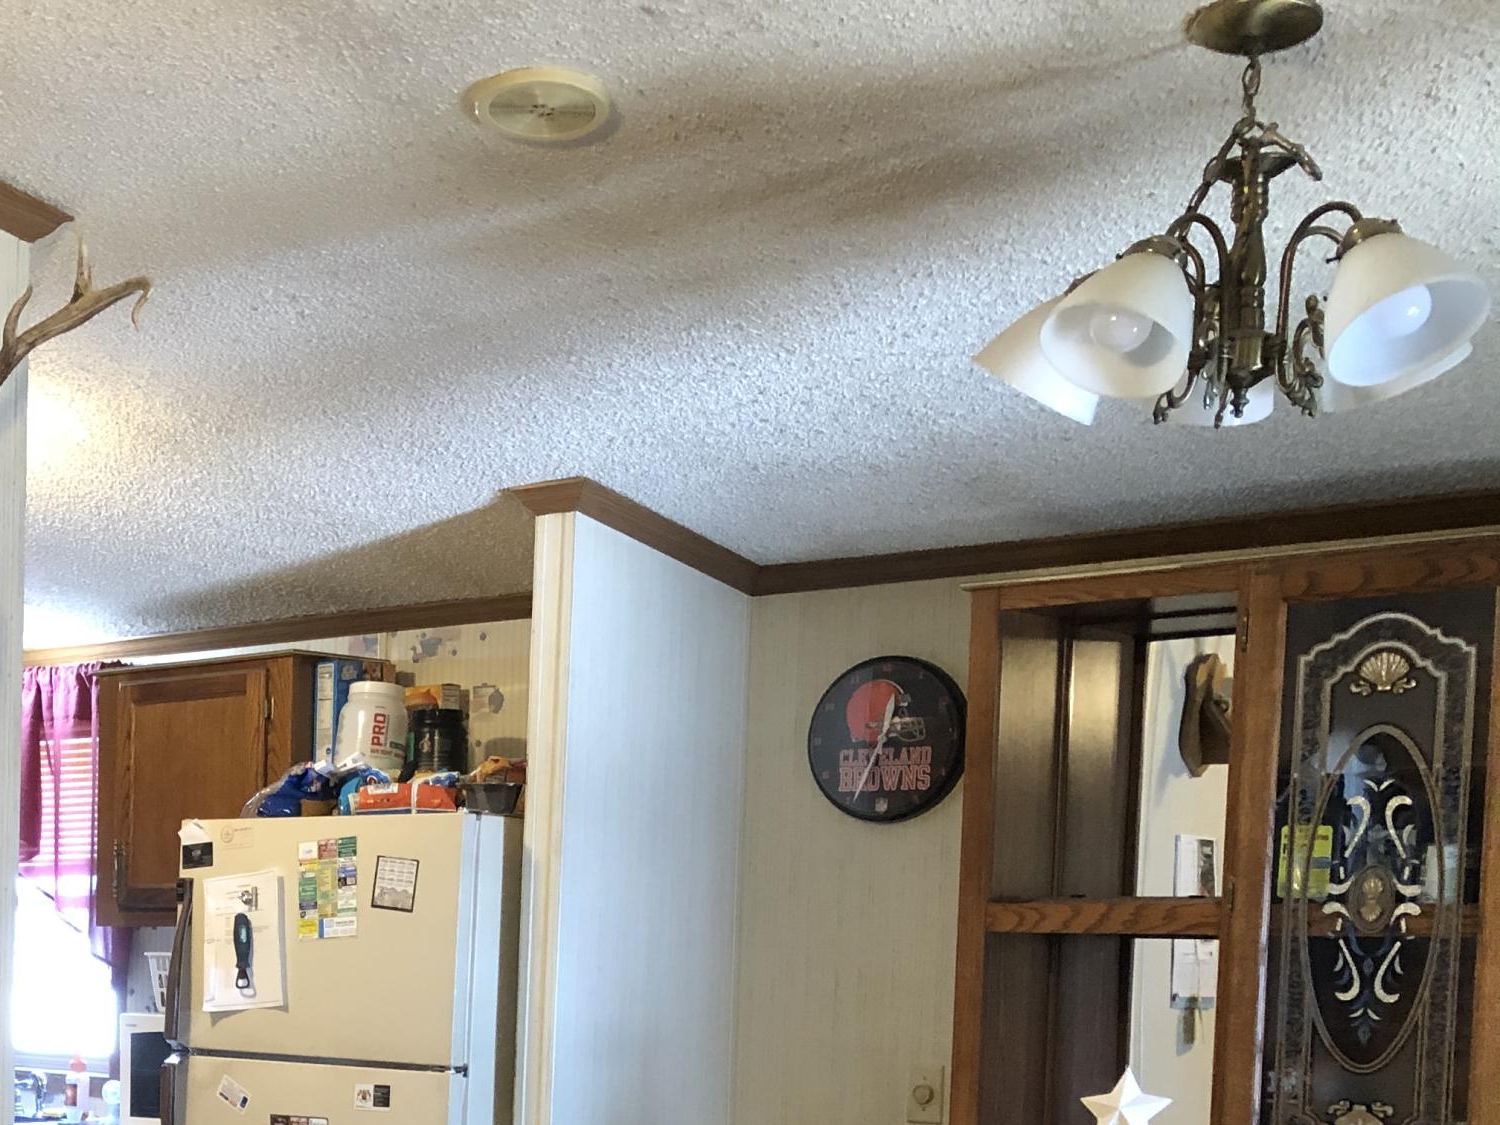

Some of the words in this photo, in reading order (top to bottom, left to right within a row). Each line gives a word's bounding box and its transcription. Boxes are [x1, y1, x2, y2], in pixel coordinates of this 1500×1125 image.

[371, 713, 387, 746] PRO
[839, 746, 932, 766] CLEELAND
[838, 765, 931, 792] BROWNS
